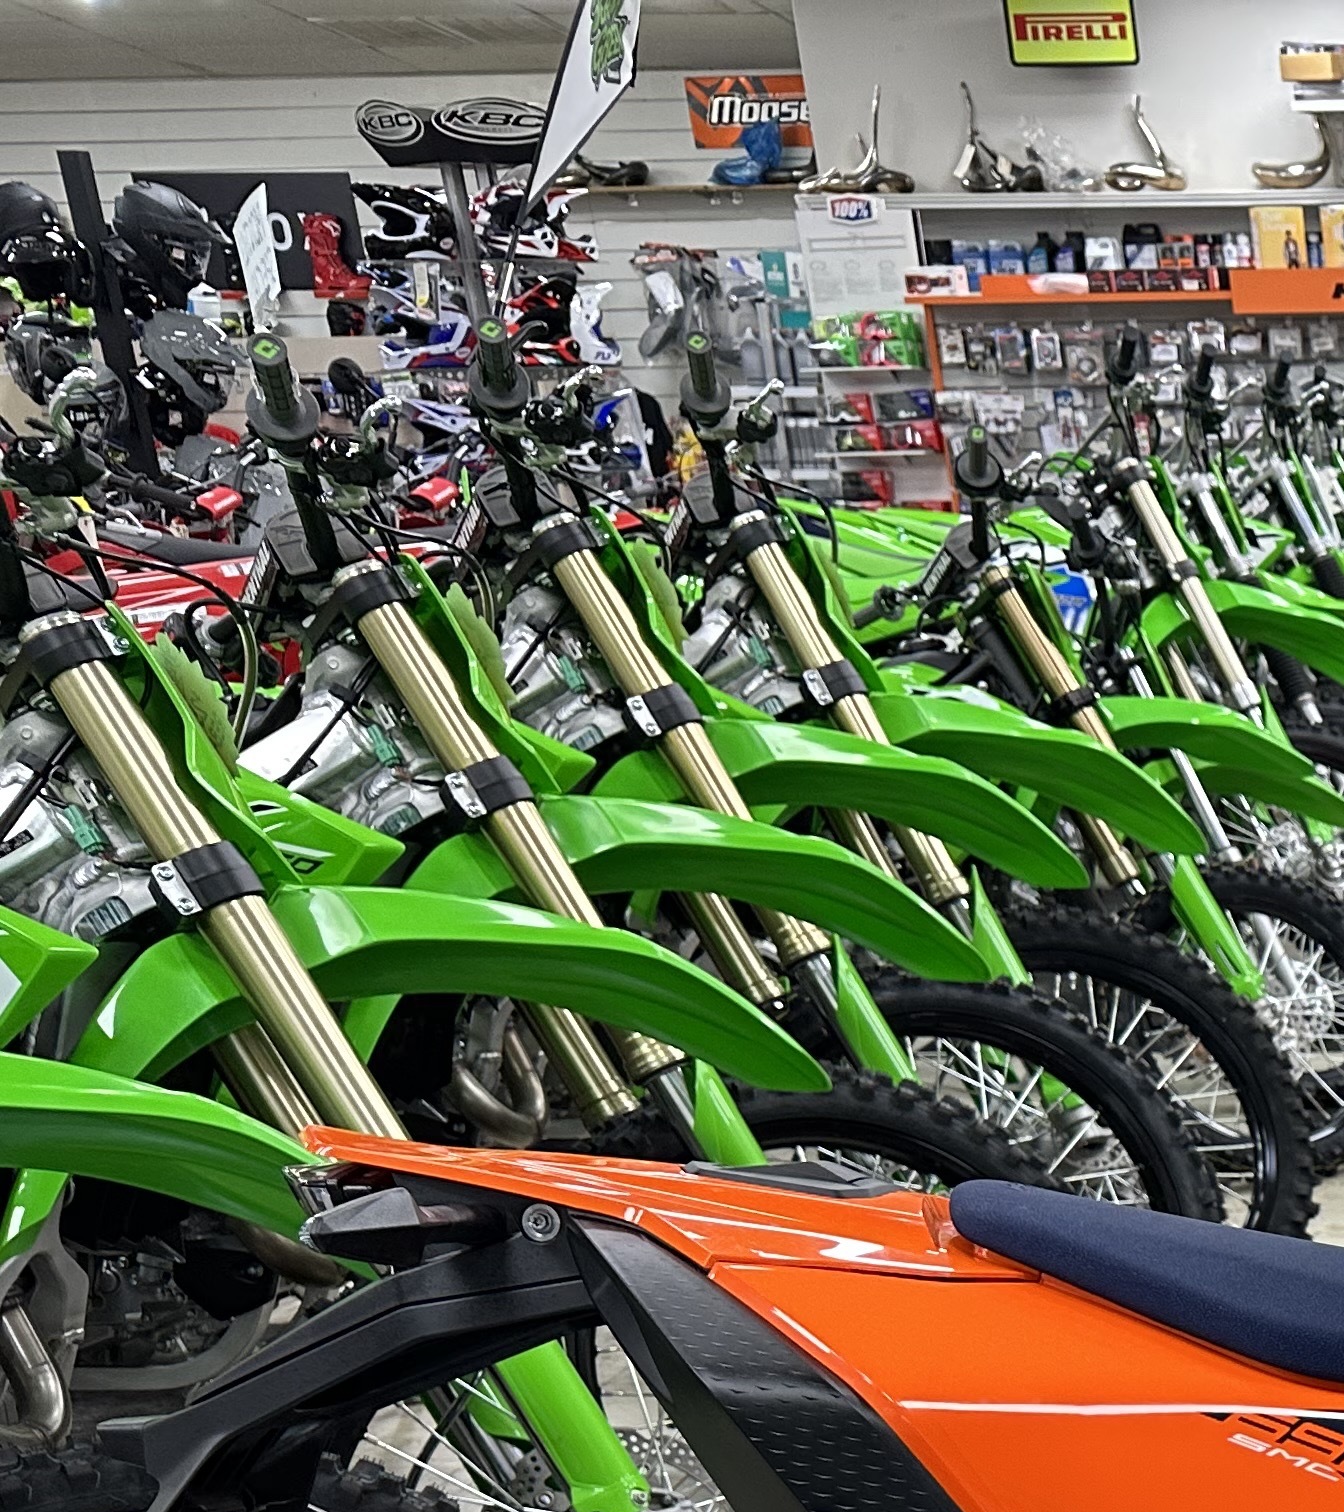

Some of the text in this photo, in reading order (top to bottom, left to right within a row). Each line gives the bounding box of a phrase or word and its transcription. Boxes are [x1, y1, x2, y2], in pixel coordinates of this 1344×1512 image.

[1014, 12, 1128, 42] PIRELLI
[361, 111, 413, 132] KBC
[445, 109, 546, 128] KBC
[832, 201, 872, 221] 100%
[1227, 1432, 1341, 1482] SMC
